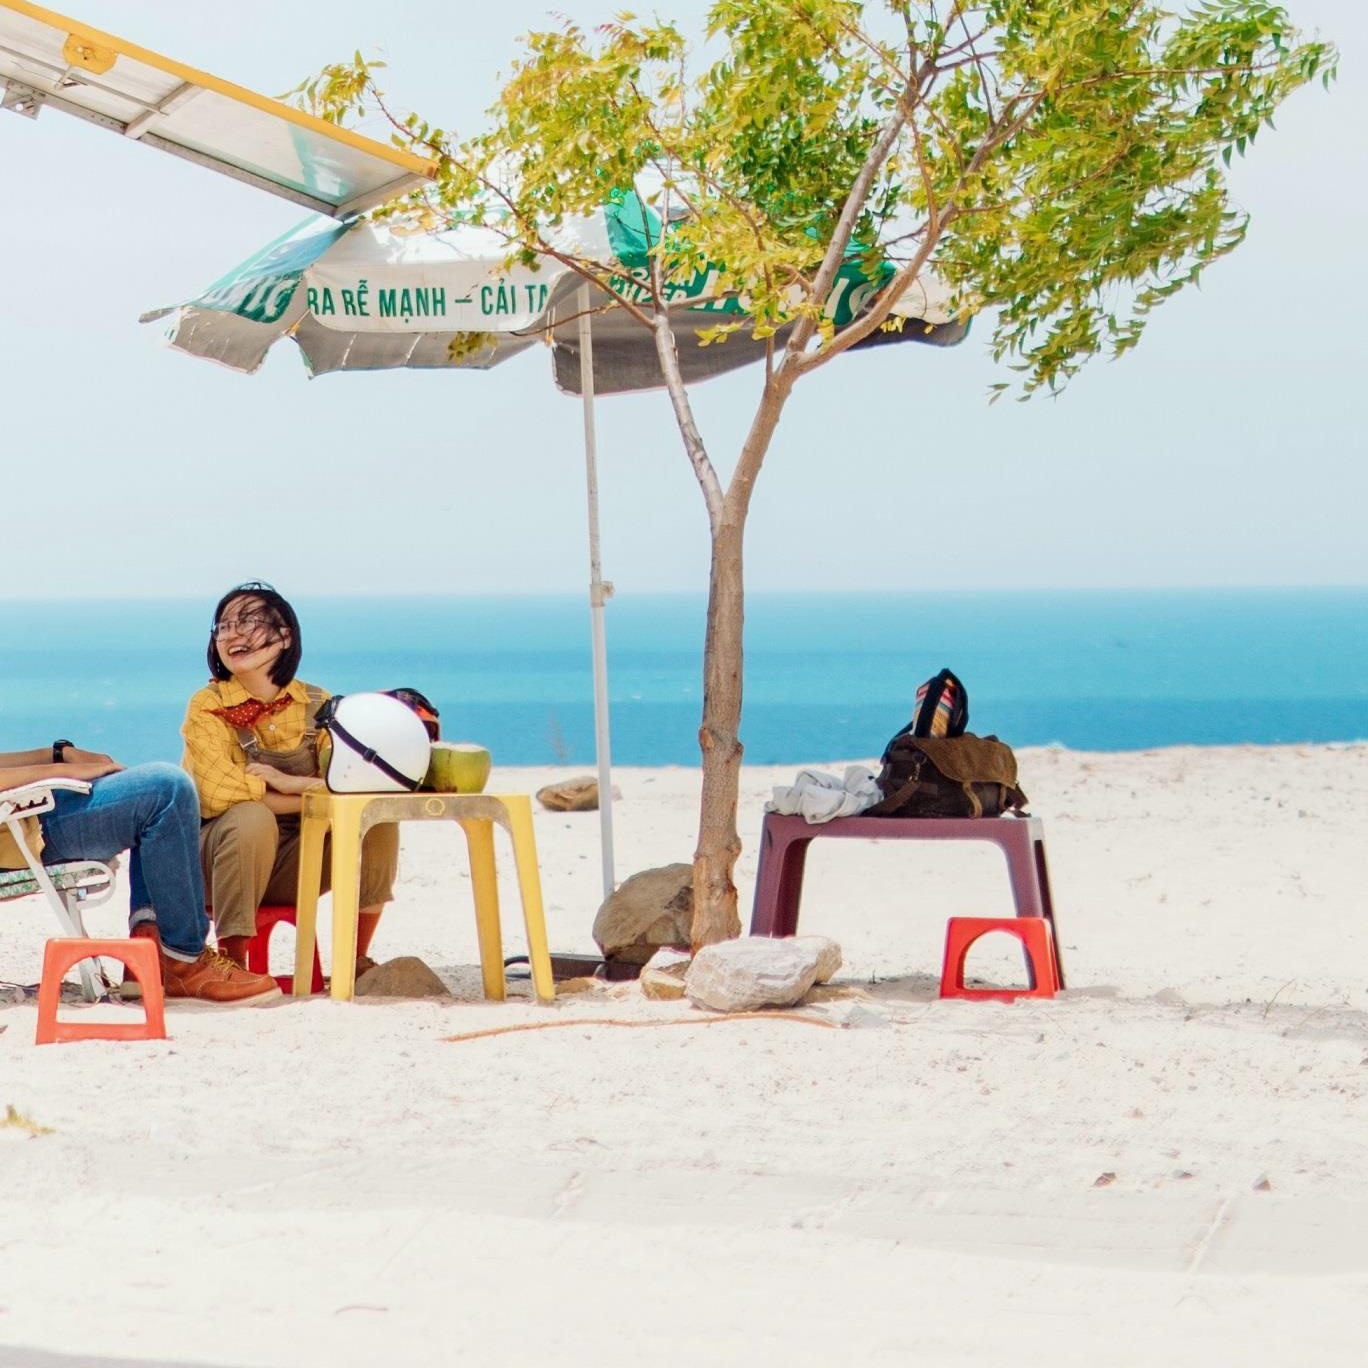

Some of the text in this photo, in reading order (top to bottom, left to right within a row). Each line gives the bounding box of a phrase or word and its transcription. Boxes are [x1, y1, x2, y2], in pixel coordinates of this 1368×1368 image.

[342, 280, 370, 316] RỄ
[379, 287, 445, 323] MẠNH
[481, 278, 516, 315] CẢI
